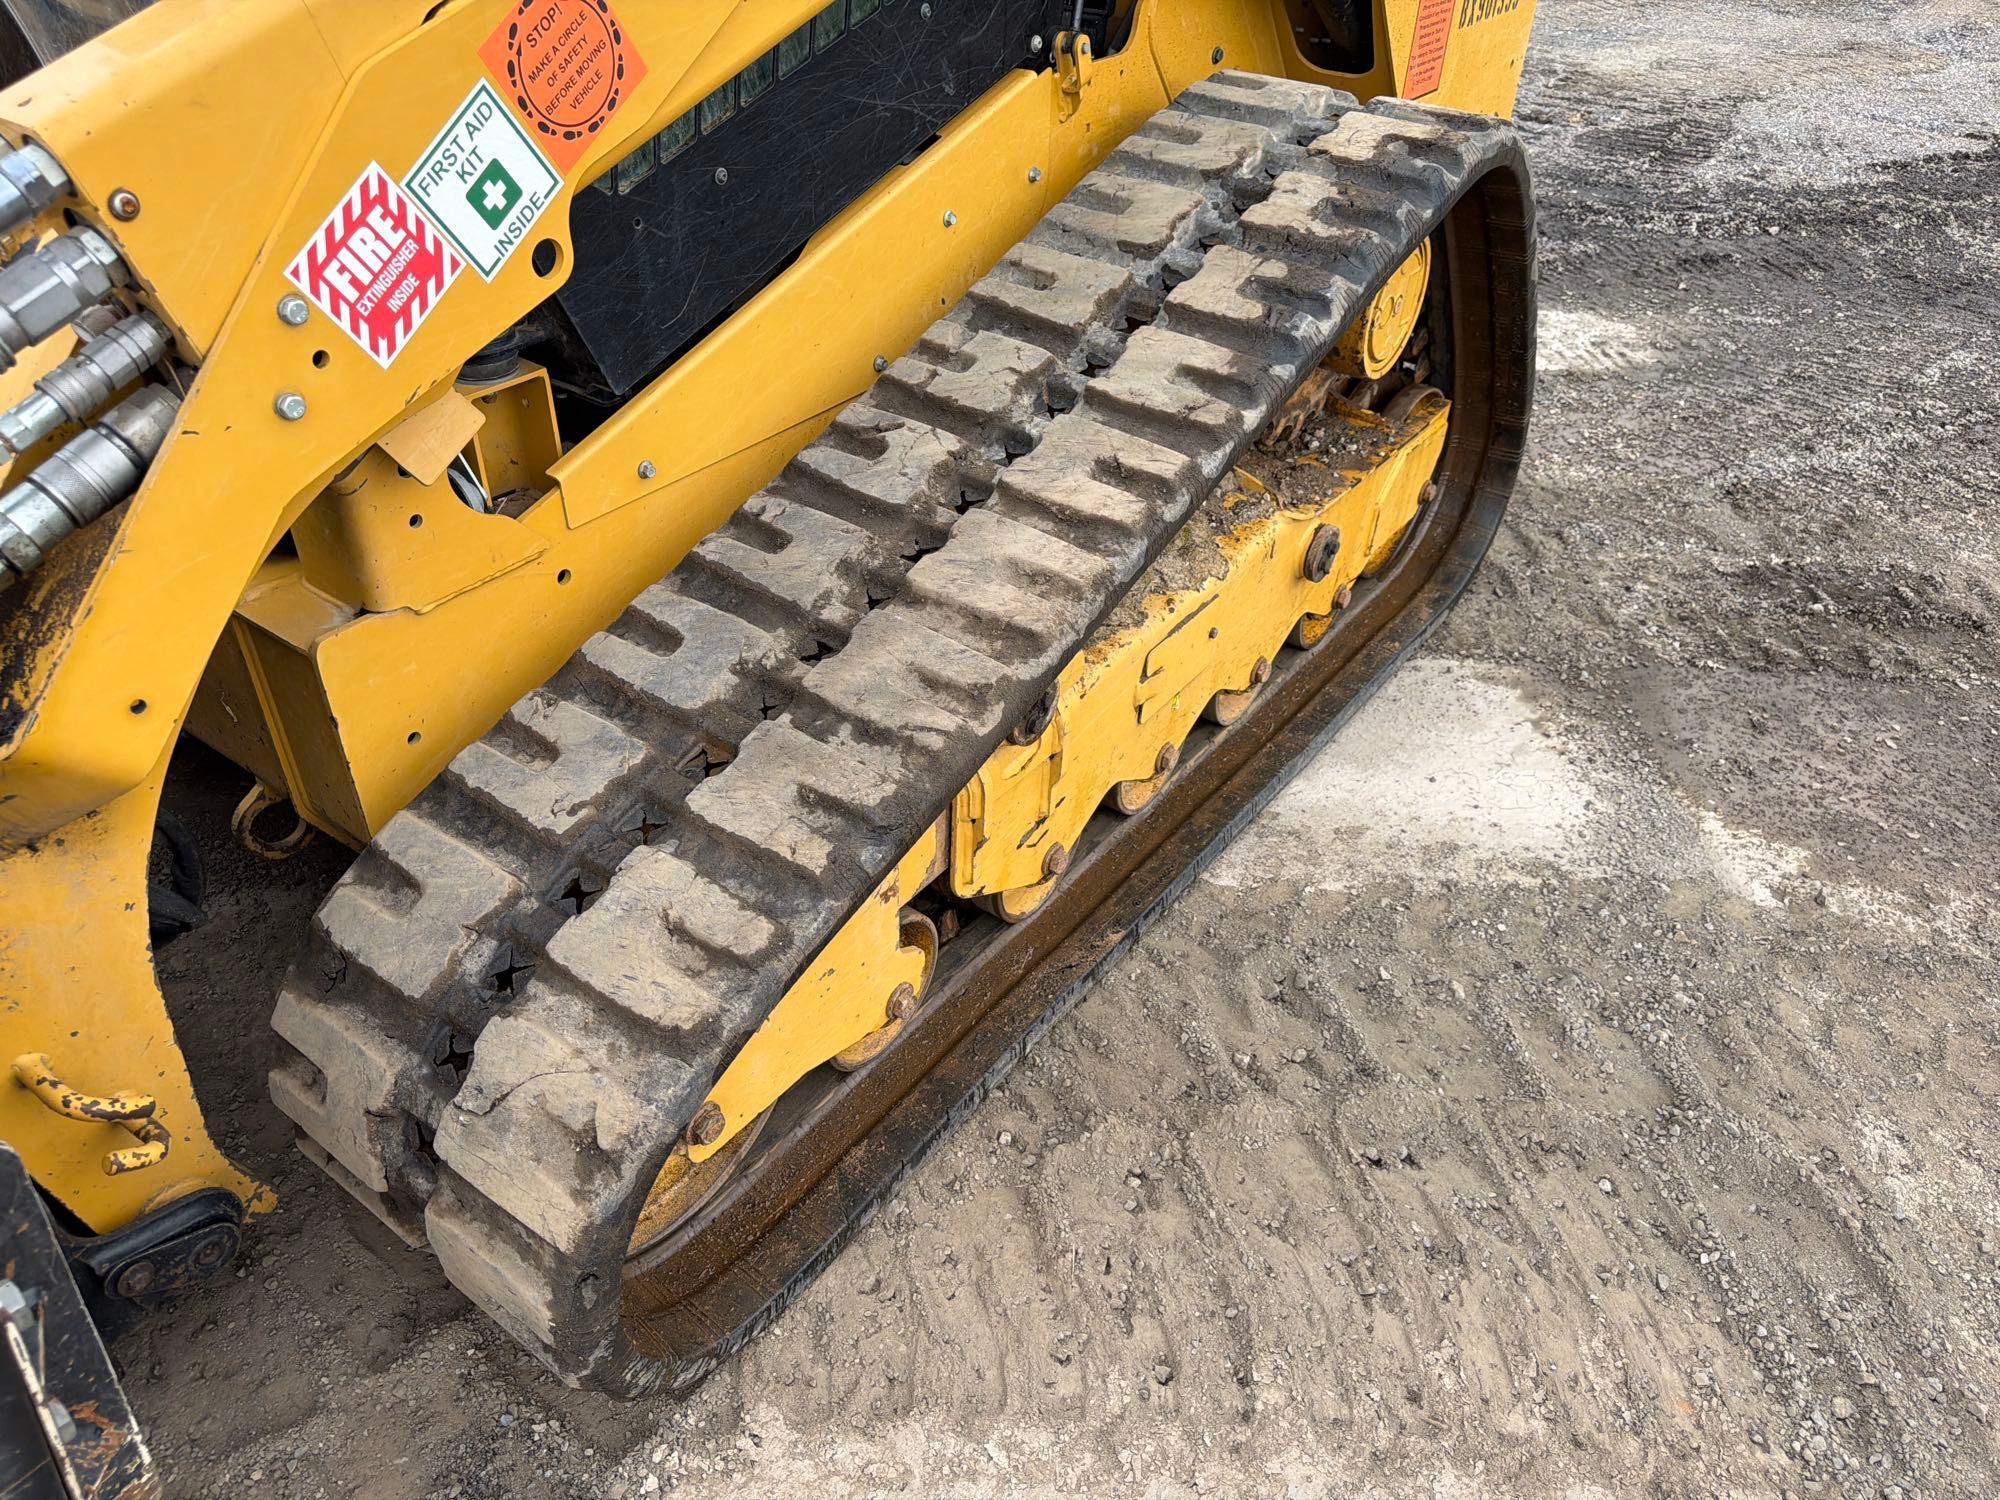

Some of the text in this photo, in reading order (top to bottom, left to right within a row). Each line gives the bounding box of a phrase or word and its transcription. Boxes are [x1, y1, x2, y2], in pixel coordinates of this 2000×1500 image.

[526, 3, 562, 48] STOP!
[528, 10, 588, 84] MAKE A CIRCLE
[545, 39, 607, 116] BEFORE MOVING
[547, 34, 588, 88] OF SAFETY
[570, 69, 603, 110] VEHICLE
[418, 101, 493, 198] FIRST AID
[455, 145, 484, 185] KIT
[322, 204, 407, 304] FIRE
[493, 191, 545, 258] INSIDE
[356, 239, 420, 317] EXTINGUISHER
[386, 272, 420, 313] INSIDE
